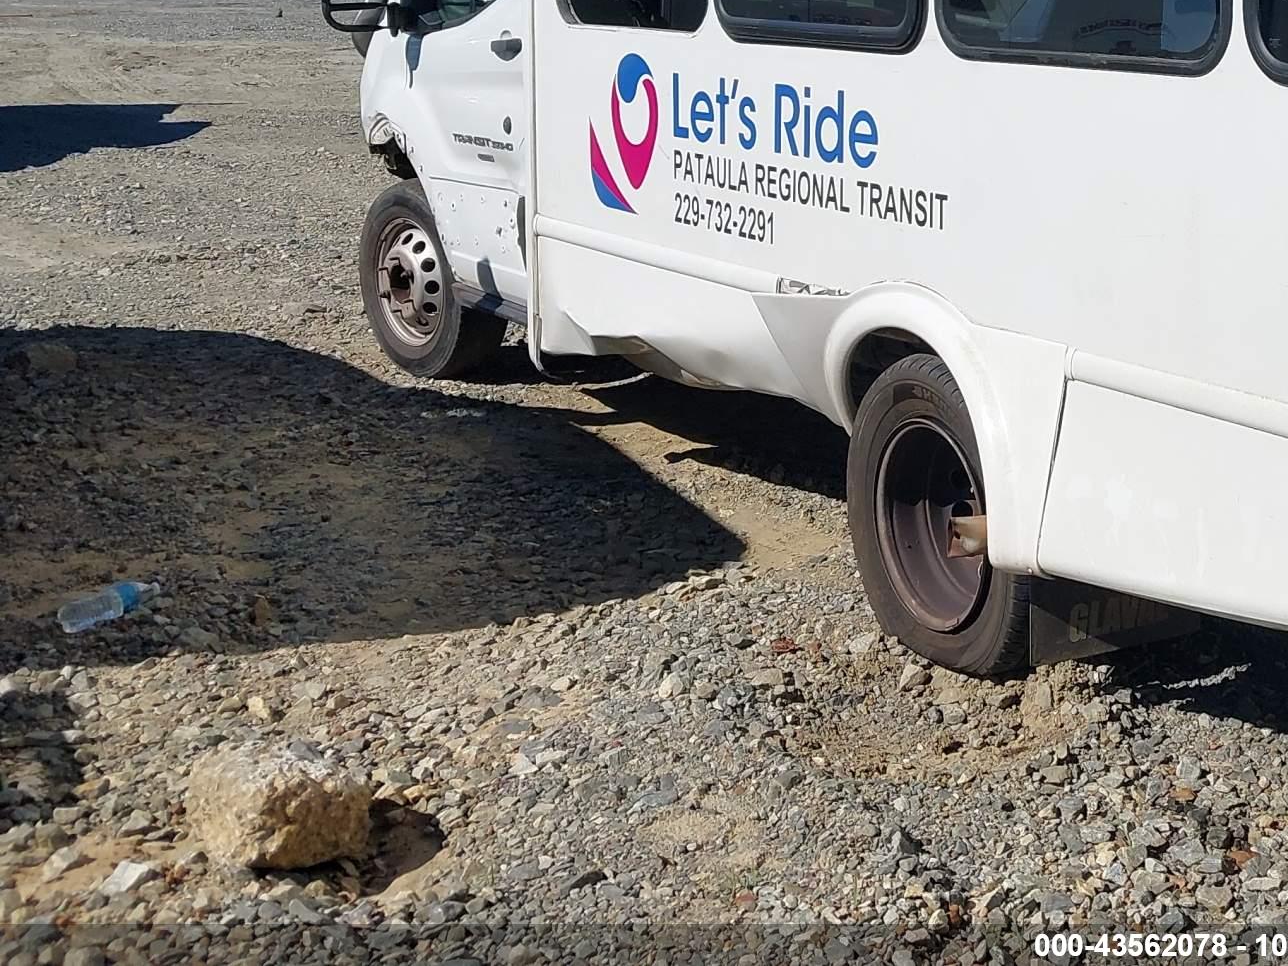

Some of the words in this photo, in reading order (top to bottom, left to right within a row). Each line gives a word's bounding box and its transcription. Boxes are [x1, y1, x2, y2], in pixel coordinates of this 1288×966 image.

[672, 72, 757, 151] Let's
[773, 83, 879, 169] Ride
[673, 149, 750, 194] PATAULA
[754, 163, 850, 214] REGIONAL
[856, 180, 948, 231] TRANSIT
[674, 192, 775, 246] 229-732-2291
